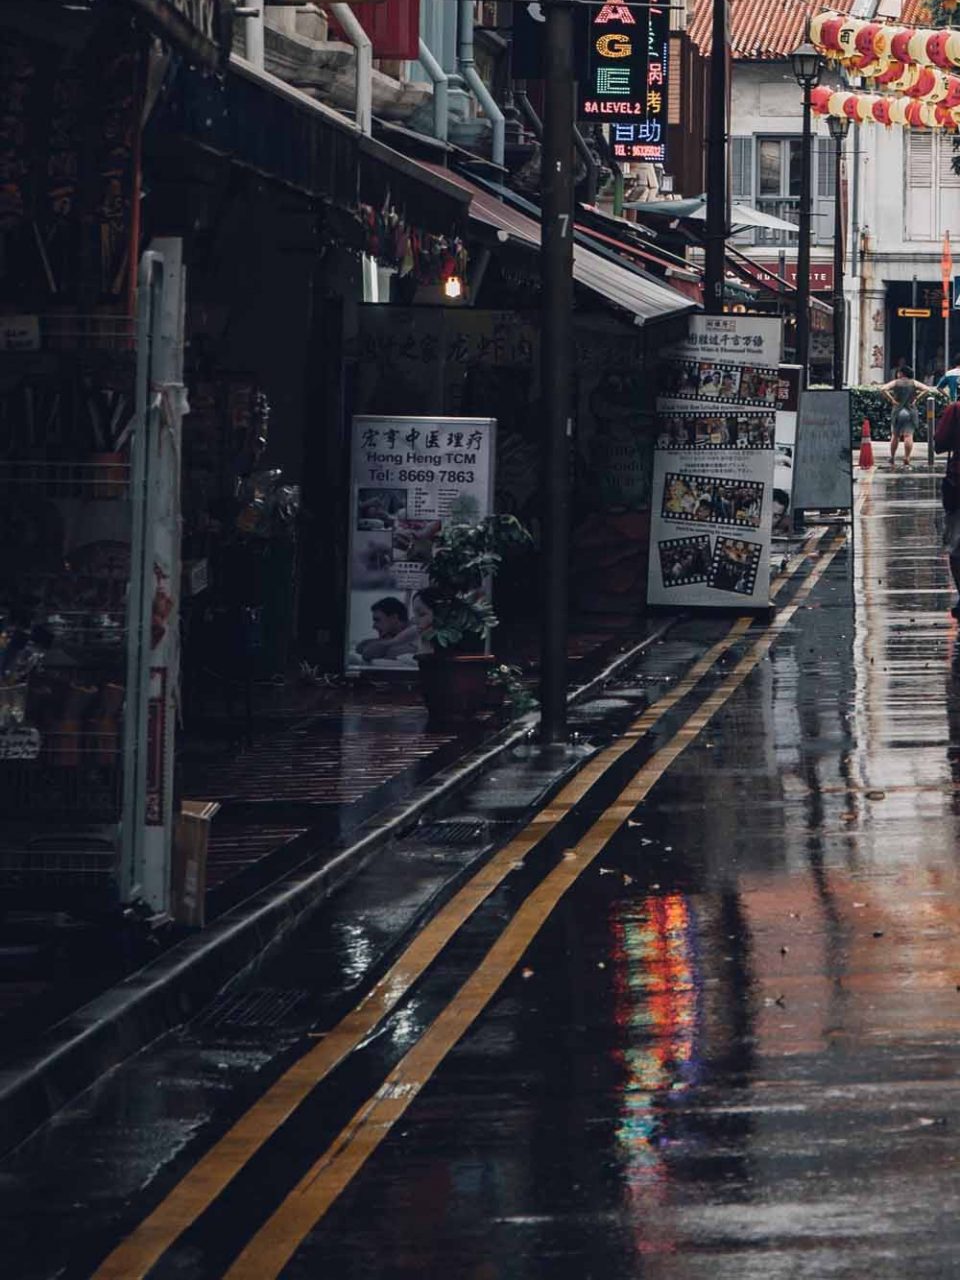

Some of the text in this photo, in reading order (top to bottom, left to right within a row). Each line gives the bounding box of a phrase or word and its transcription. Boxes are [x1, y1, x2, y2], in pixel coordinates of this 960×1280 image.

[601, 102, 632, 114] LEVEL
[634, 103, 641, 114] 2
[558, 213, 569, 238] 7
[791, 273, 827, 281] TSTE
[367, 452, 476, 465] Hong Heng TCM
[368, 469, 475, 483] Tel: 8669 7863
